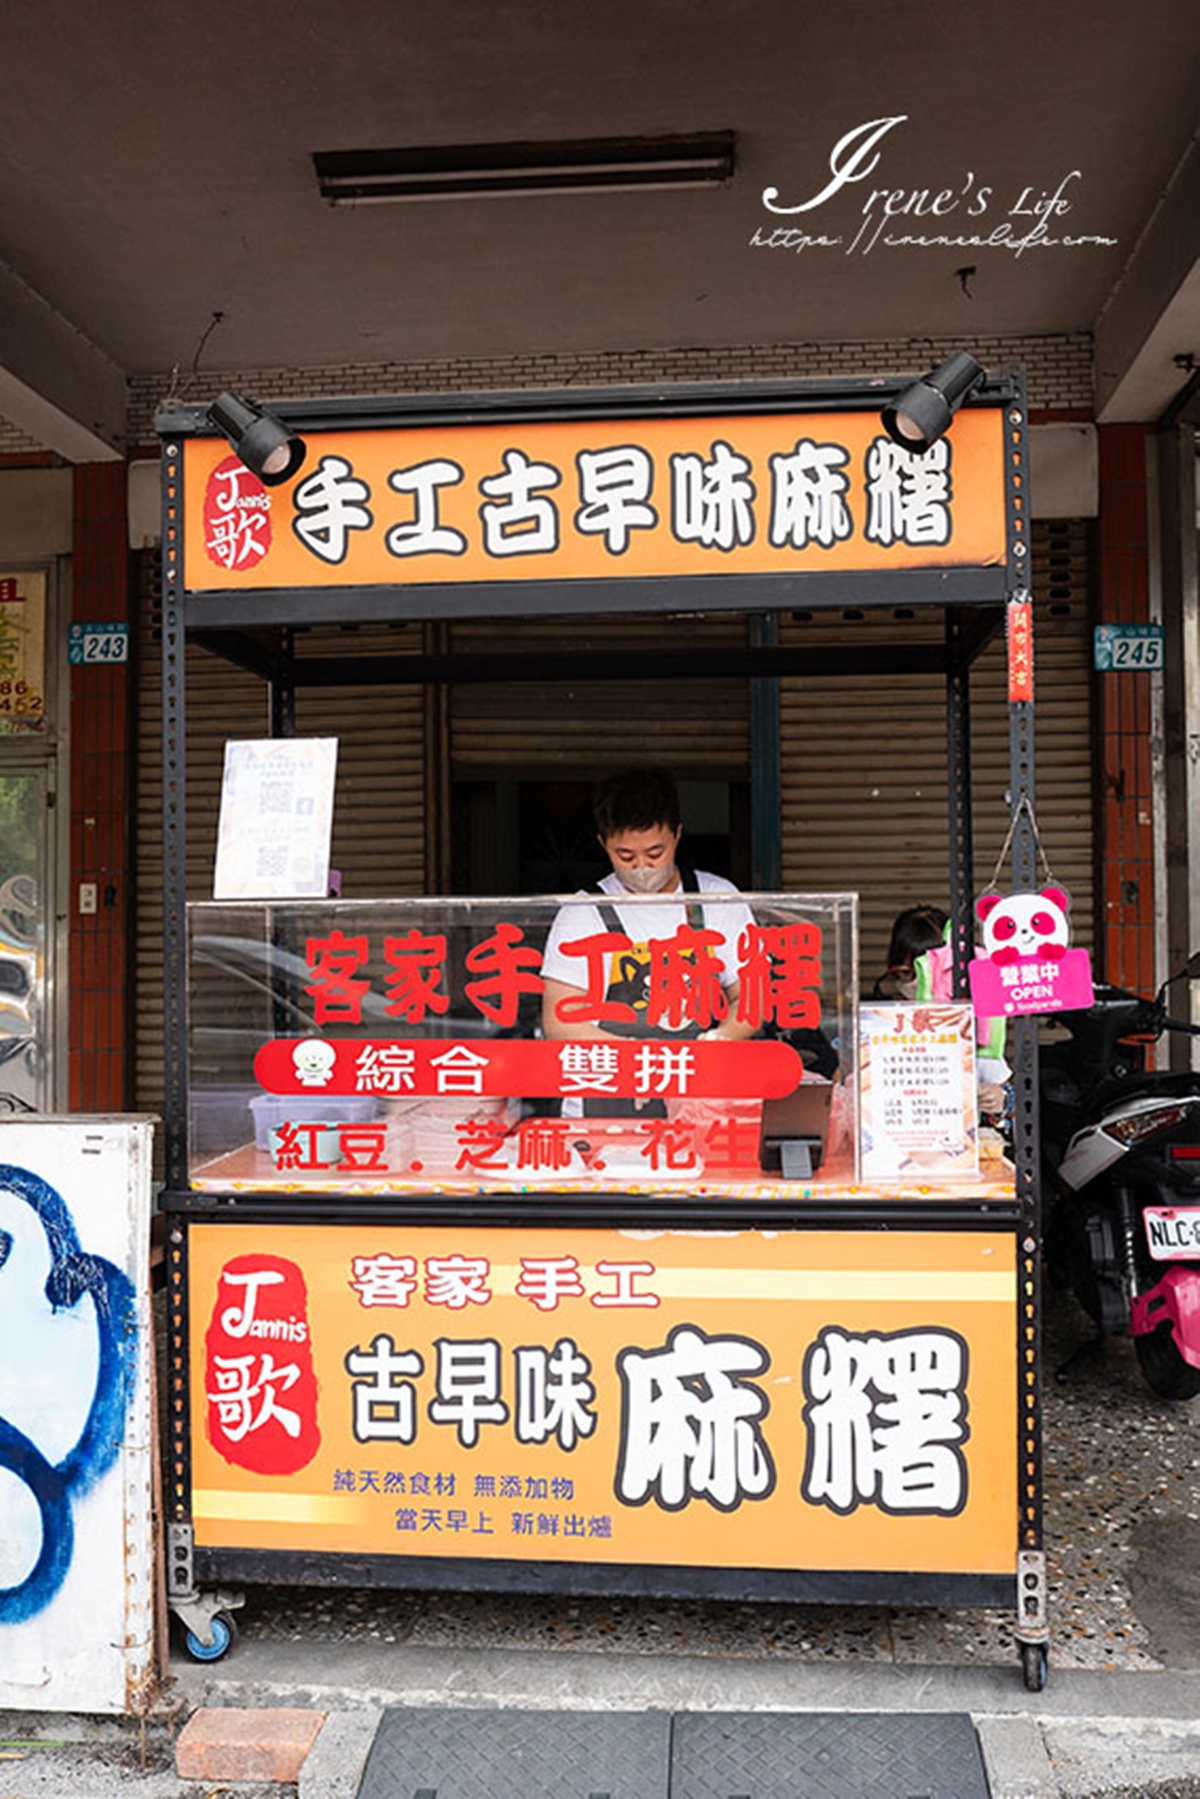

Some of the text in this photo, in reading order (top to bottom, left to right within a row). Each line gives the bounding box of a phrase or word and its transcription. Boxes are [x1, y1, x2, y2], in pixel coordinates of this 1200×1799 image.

[292, 437, 952, 564] 手工古早味麻糬
[207, 509, 267, 569] 歌
[86, 636, 125, 658] 243
[1116, 640, 1159, 664] 245
[304, 923, 822, 1029] 客家手工麻糬
[1010, 984, 1054, 1001] OPEN
[355, 1044, 695, 1094] 綜合 雙拼
[220, 1271, 308, 1343] Jannis
[348, 1253, 661, 1311] 客家 手工
[208, 1353, 301, 1442] 歌
[345, 1322, 971, 1517] 古早味 麻糬
[333, 1469, 575, 1501] 純天然食材 無添加物
[395, 1508, 612, 1539] 當天早上 新鮮出爐
